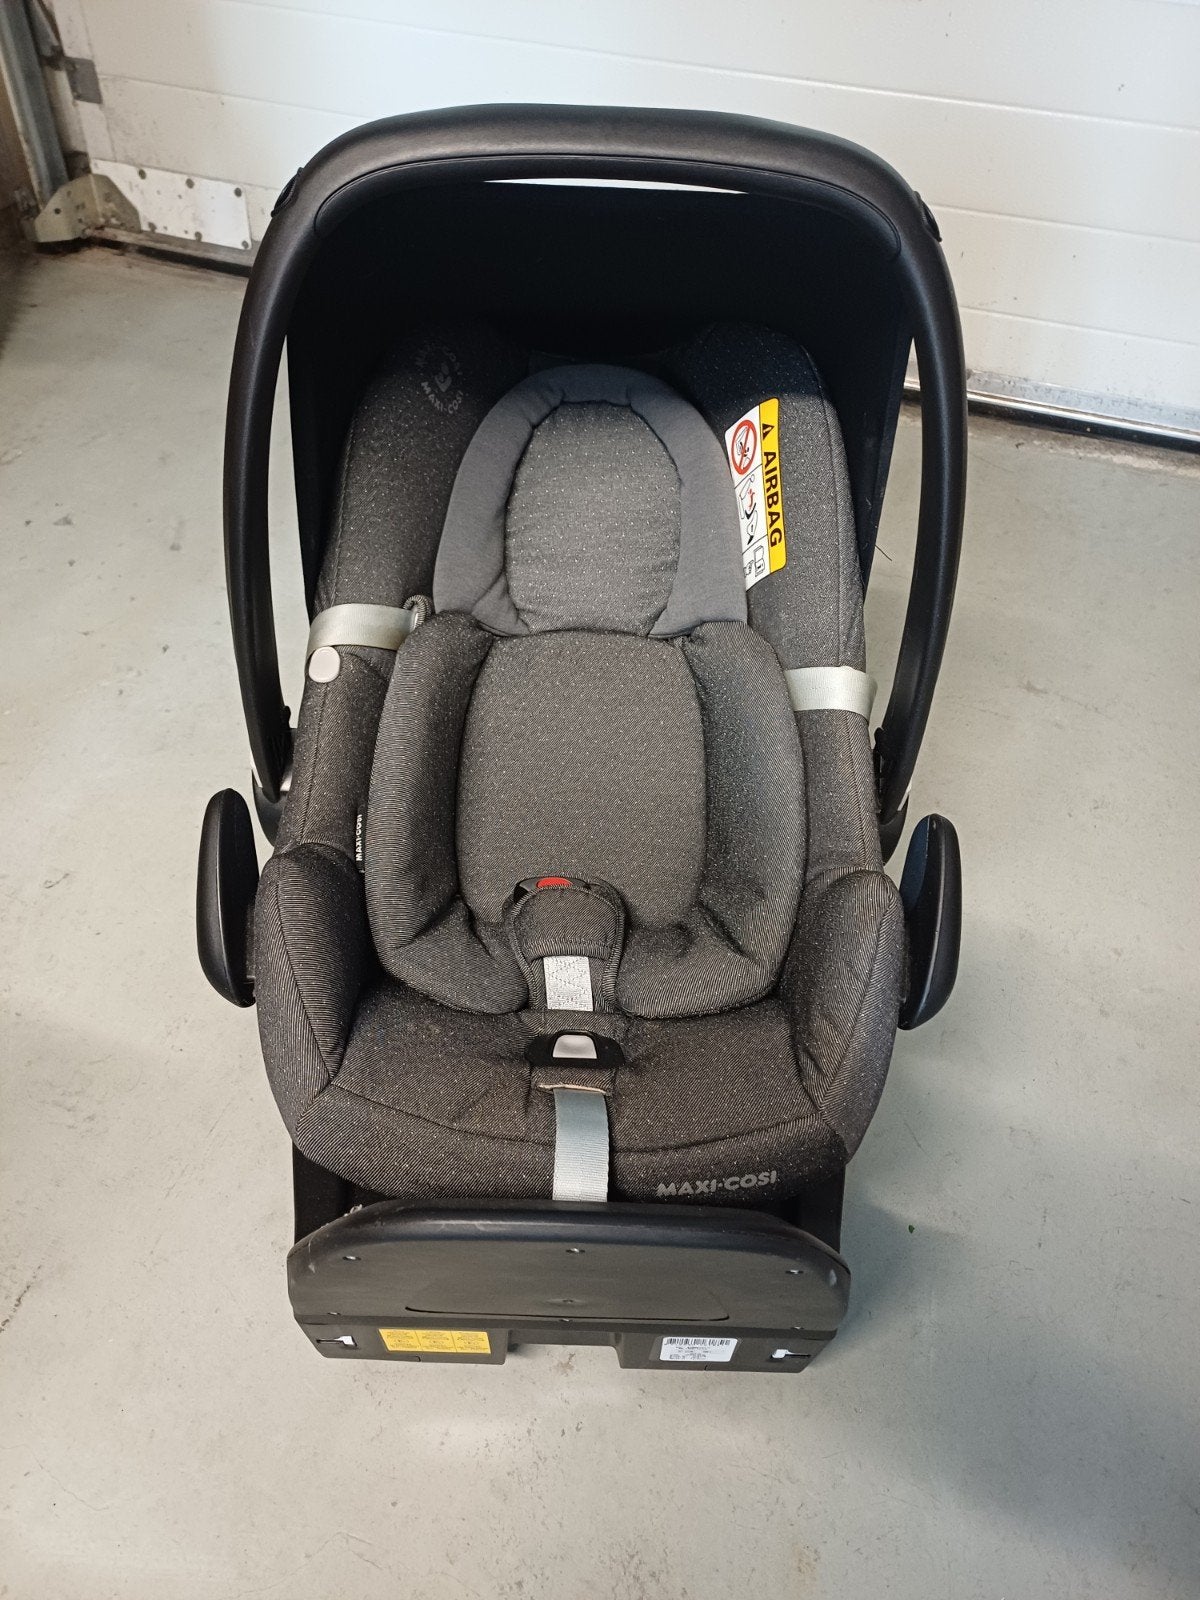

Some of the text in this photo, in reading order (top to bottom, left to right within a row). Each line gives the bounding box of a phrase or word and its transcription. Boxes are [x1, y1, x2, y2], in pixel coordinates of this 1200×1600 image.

[421, 381, 463, 414] MAXI-COSI
[763, 451, 783, 548] AIRBAG
[656, 1170, 777, 1197] MAXI-COSI
